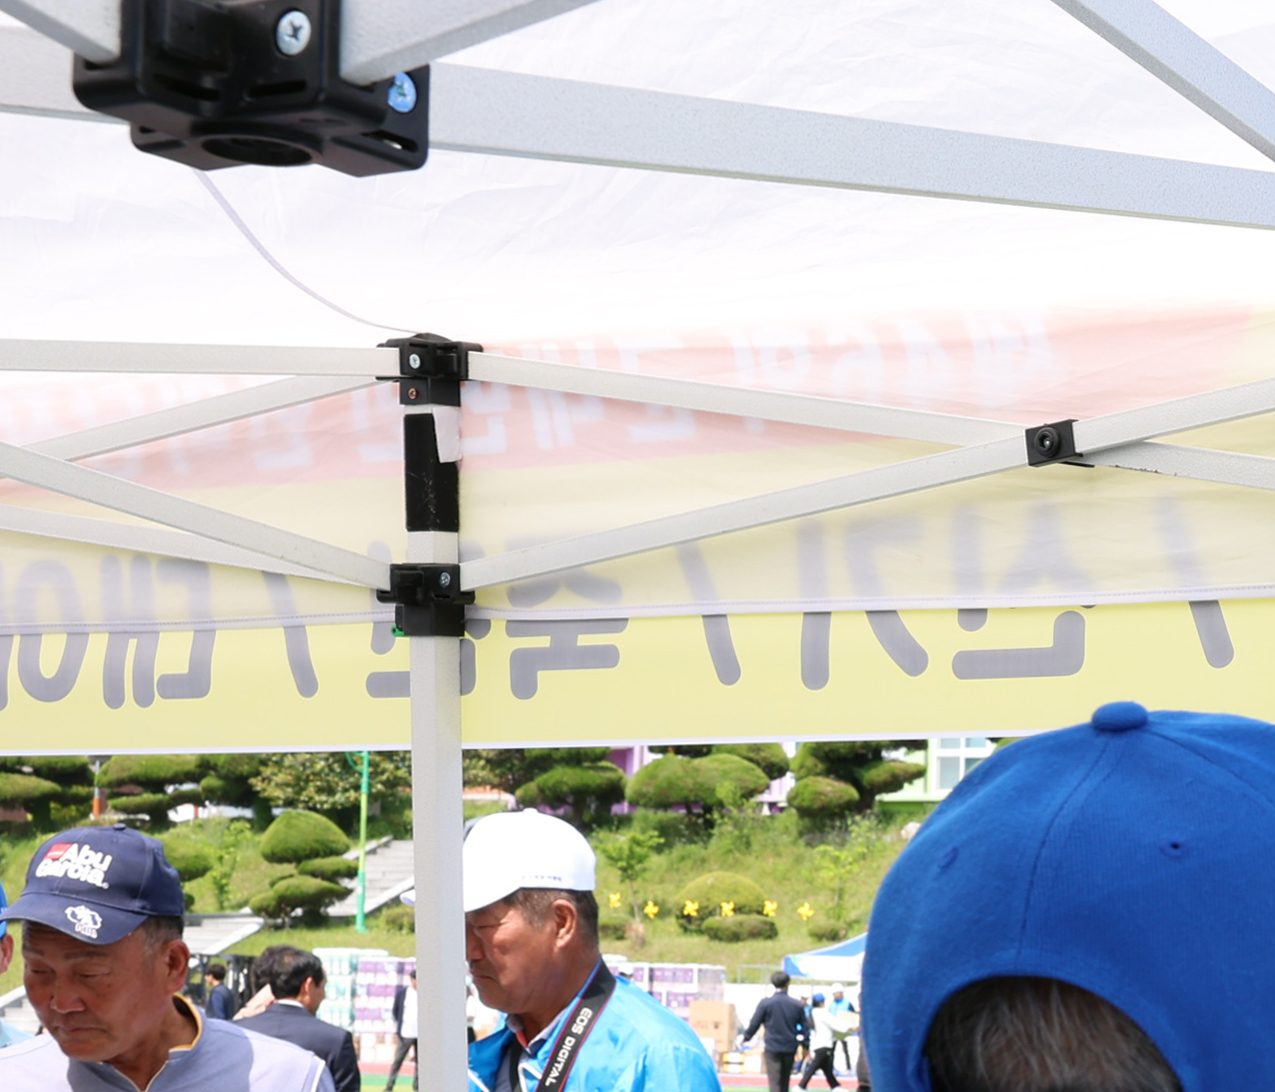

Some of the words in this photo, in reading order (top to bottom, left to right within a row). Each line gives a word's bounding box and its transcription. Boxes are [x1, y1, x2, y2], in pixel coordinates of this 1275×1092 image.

[59, 843, 113, 871] Abu
[571, 1007, 593, 1035] EOS
[545, 1036, 577, 1087] DIGITAL
